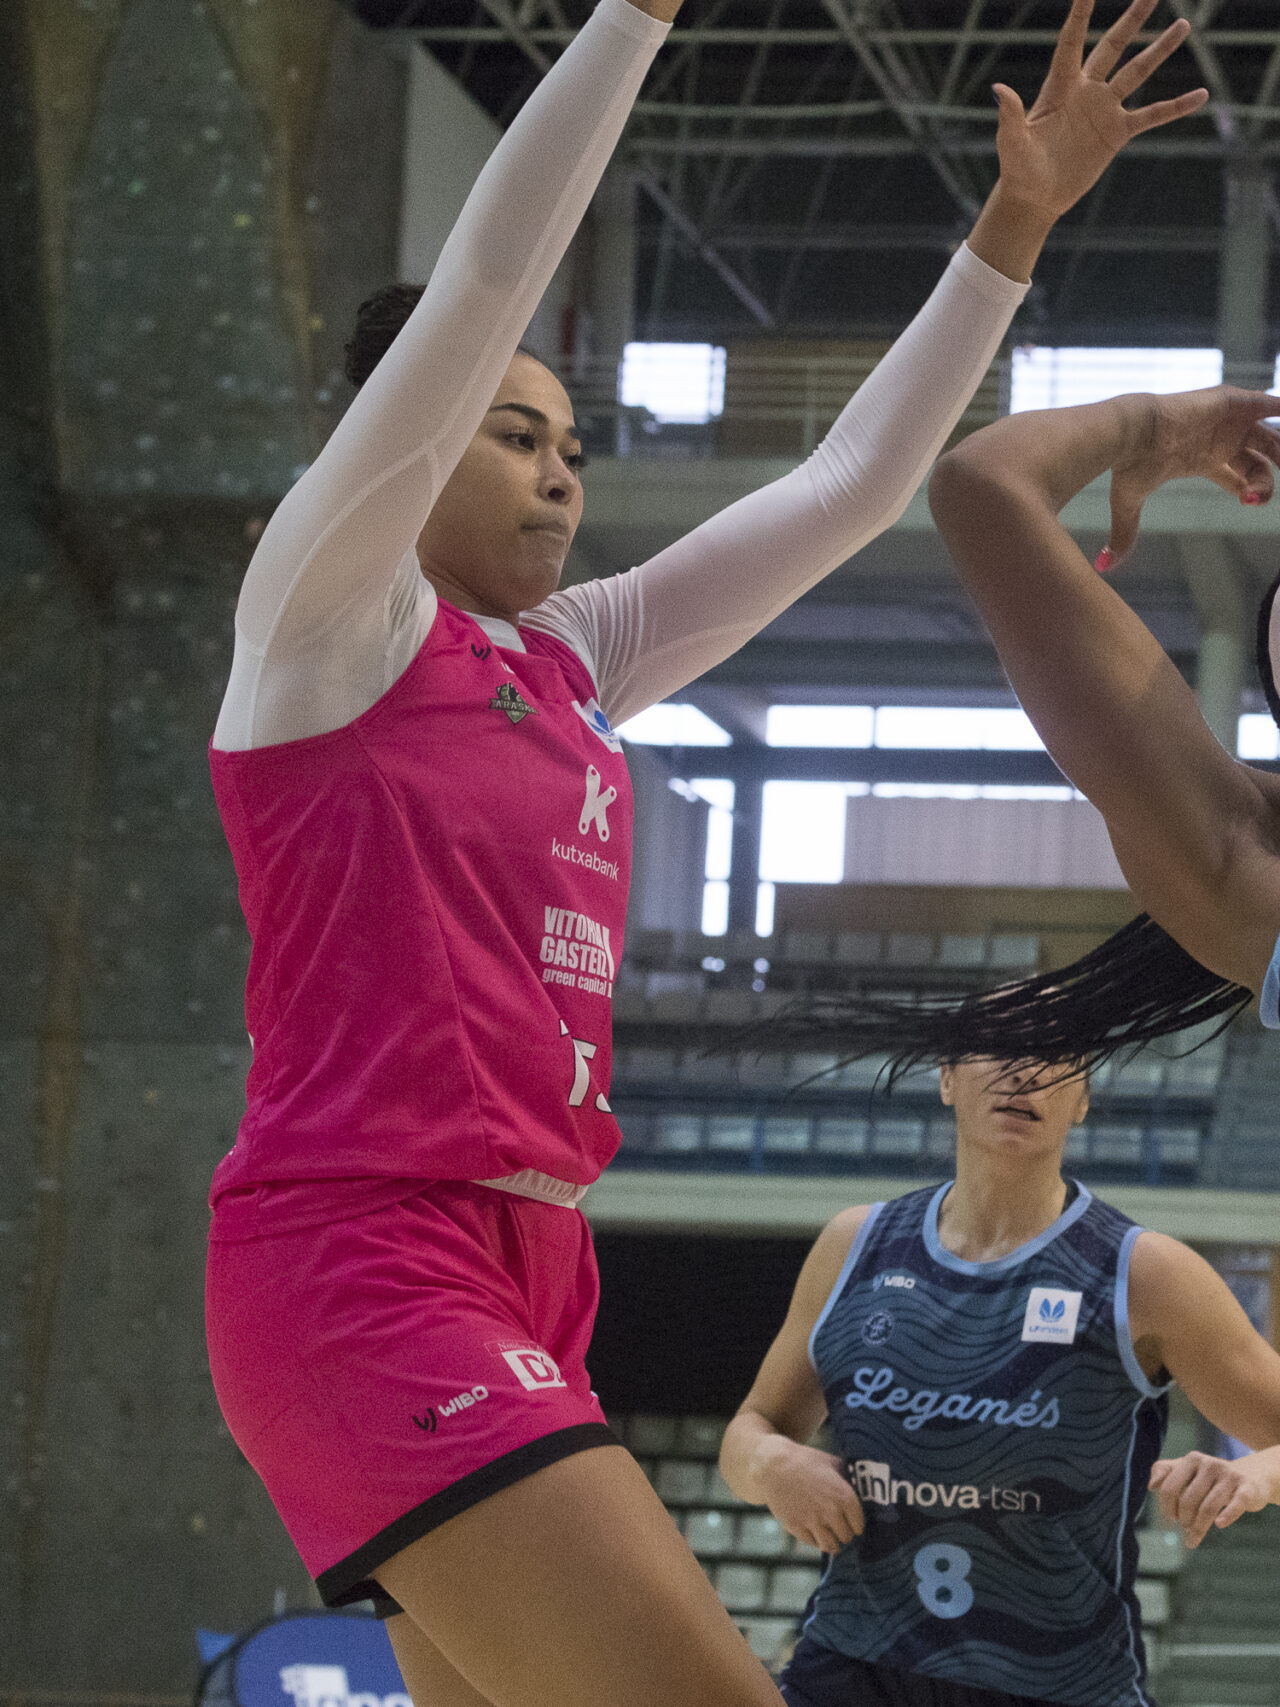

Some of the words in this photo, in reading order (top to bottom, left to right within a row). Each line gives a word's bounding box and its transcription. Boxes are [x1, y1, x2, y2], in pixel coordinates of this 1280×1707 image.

[551, 837, 620, 881] kutxabank
[543, 968, 576, 988] green
[577, 975, 607, 997] capital
[438, 1385, 489, 1417] WIBO
[845, 1366, 1060, 1431] Leganés
[913, 1542, 975, 1619] 8
